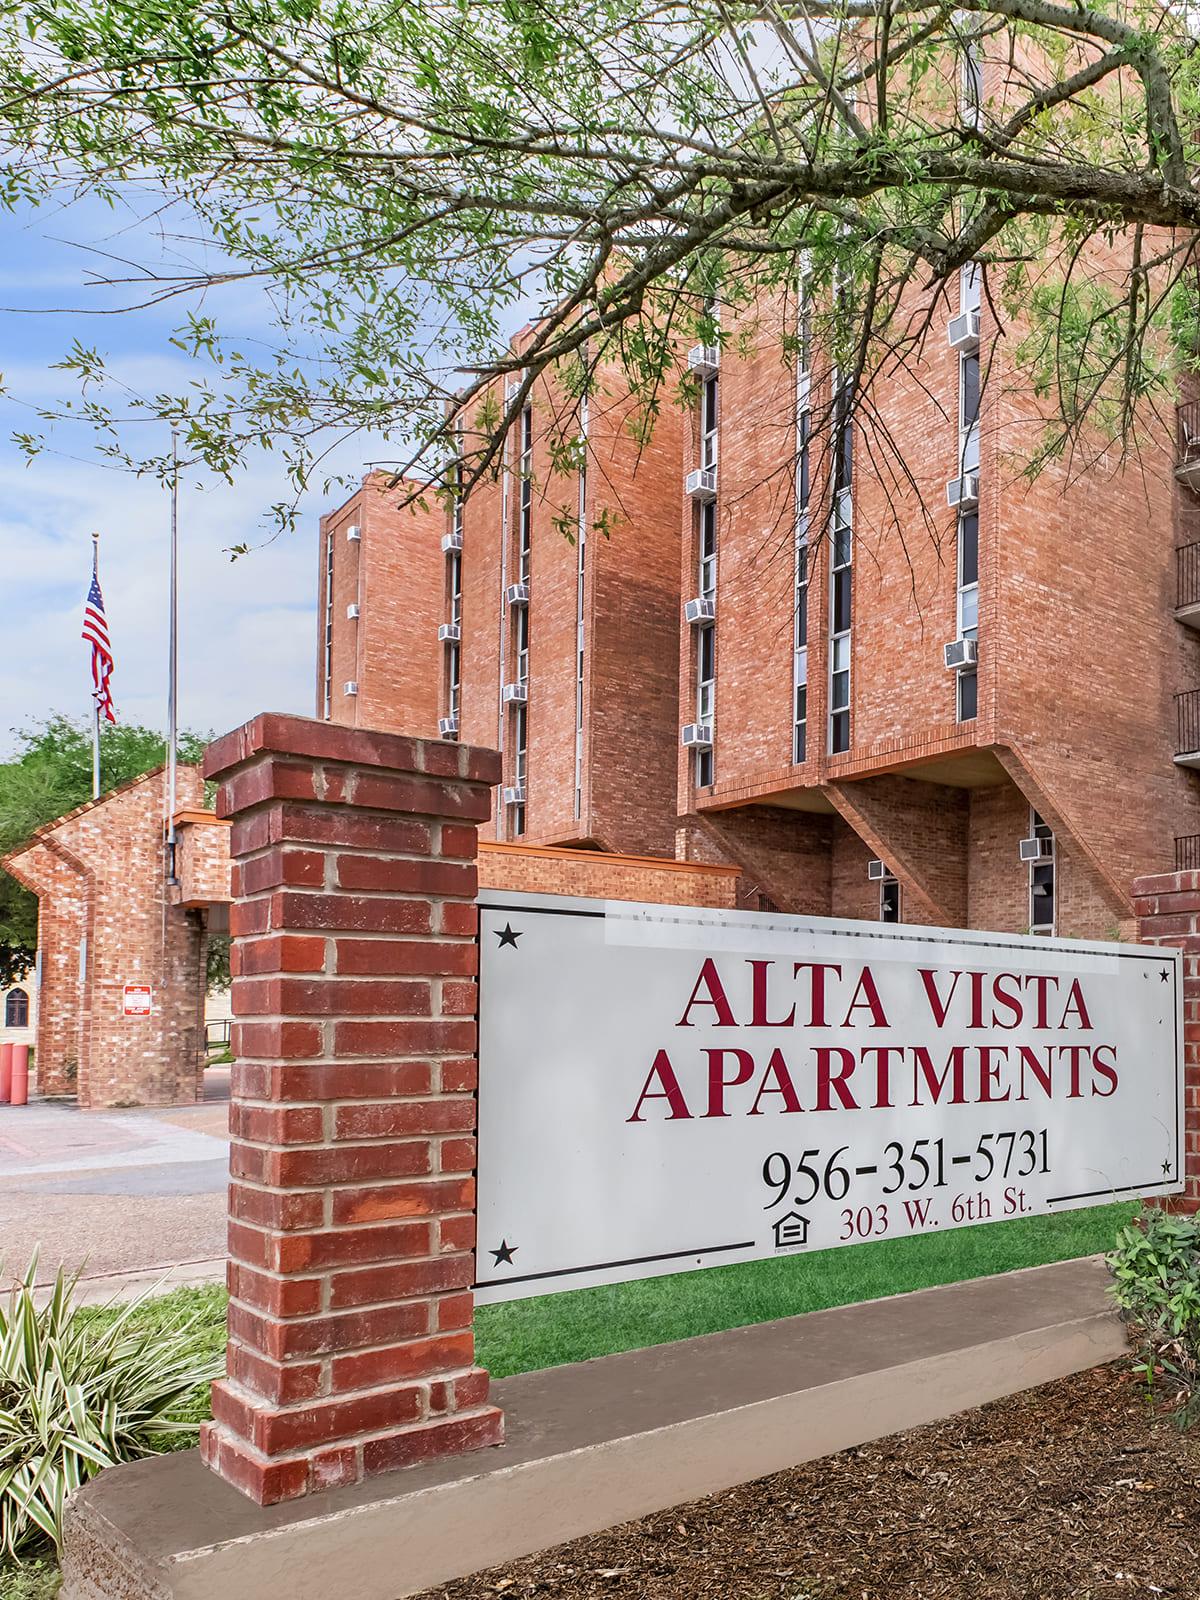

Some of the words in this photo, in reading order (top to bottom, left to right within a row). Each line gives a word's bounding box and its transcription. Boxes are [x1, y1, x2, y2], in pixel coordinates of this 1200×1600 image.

[675, 957, 892, 1028] ALTA
[916, 968, 1095, 1030] VISTA
[625, 1044, 1119, 1123] APARTMENTS
[762, 1128, 1052, 1210] 956-351-5731
[839, 1203, 889, 1241] 303
[951, 1190, 993, 1223] 6th
[1003, 1185, 1033, 1215] St.
